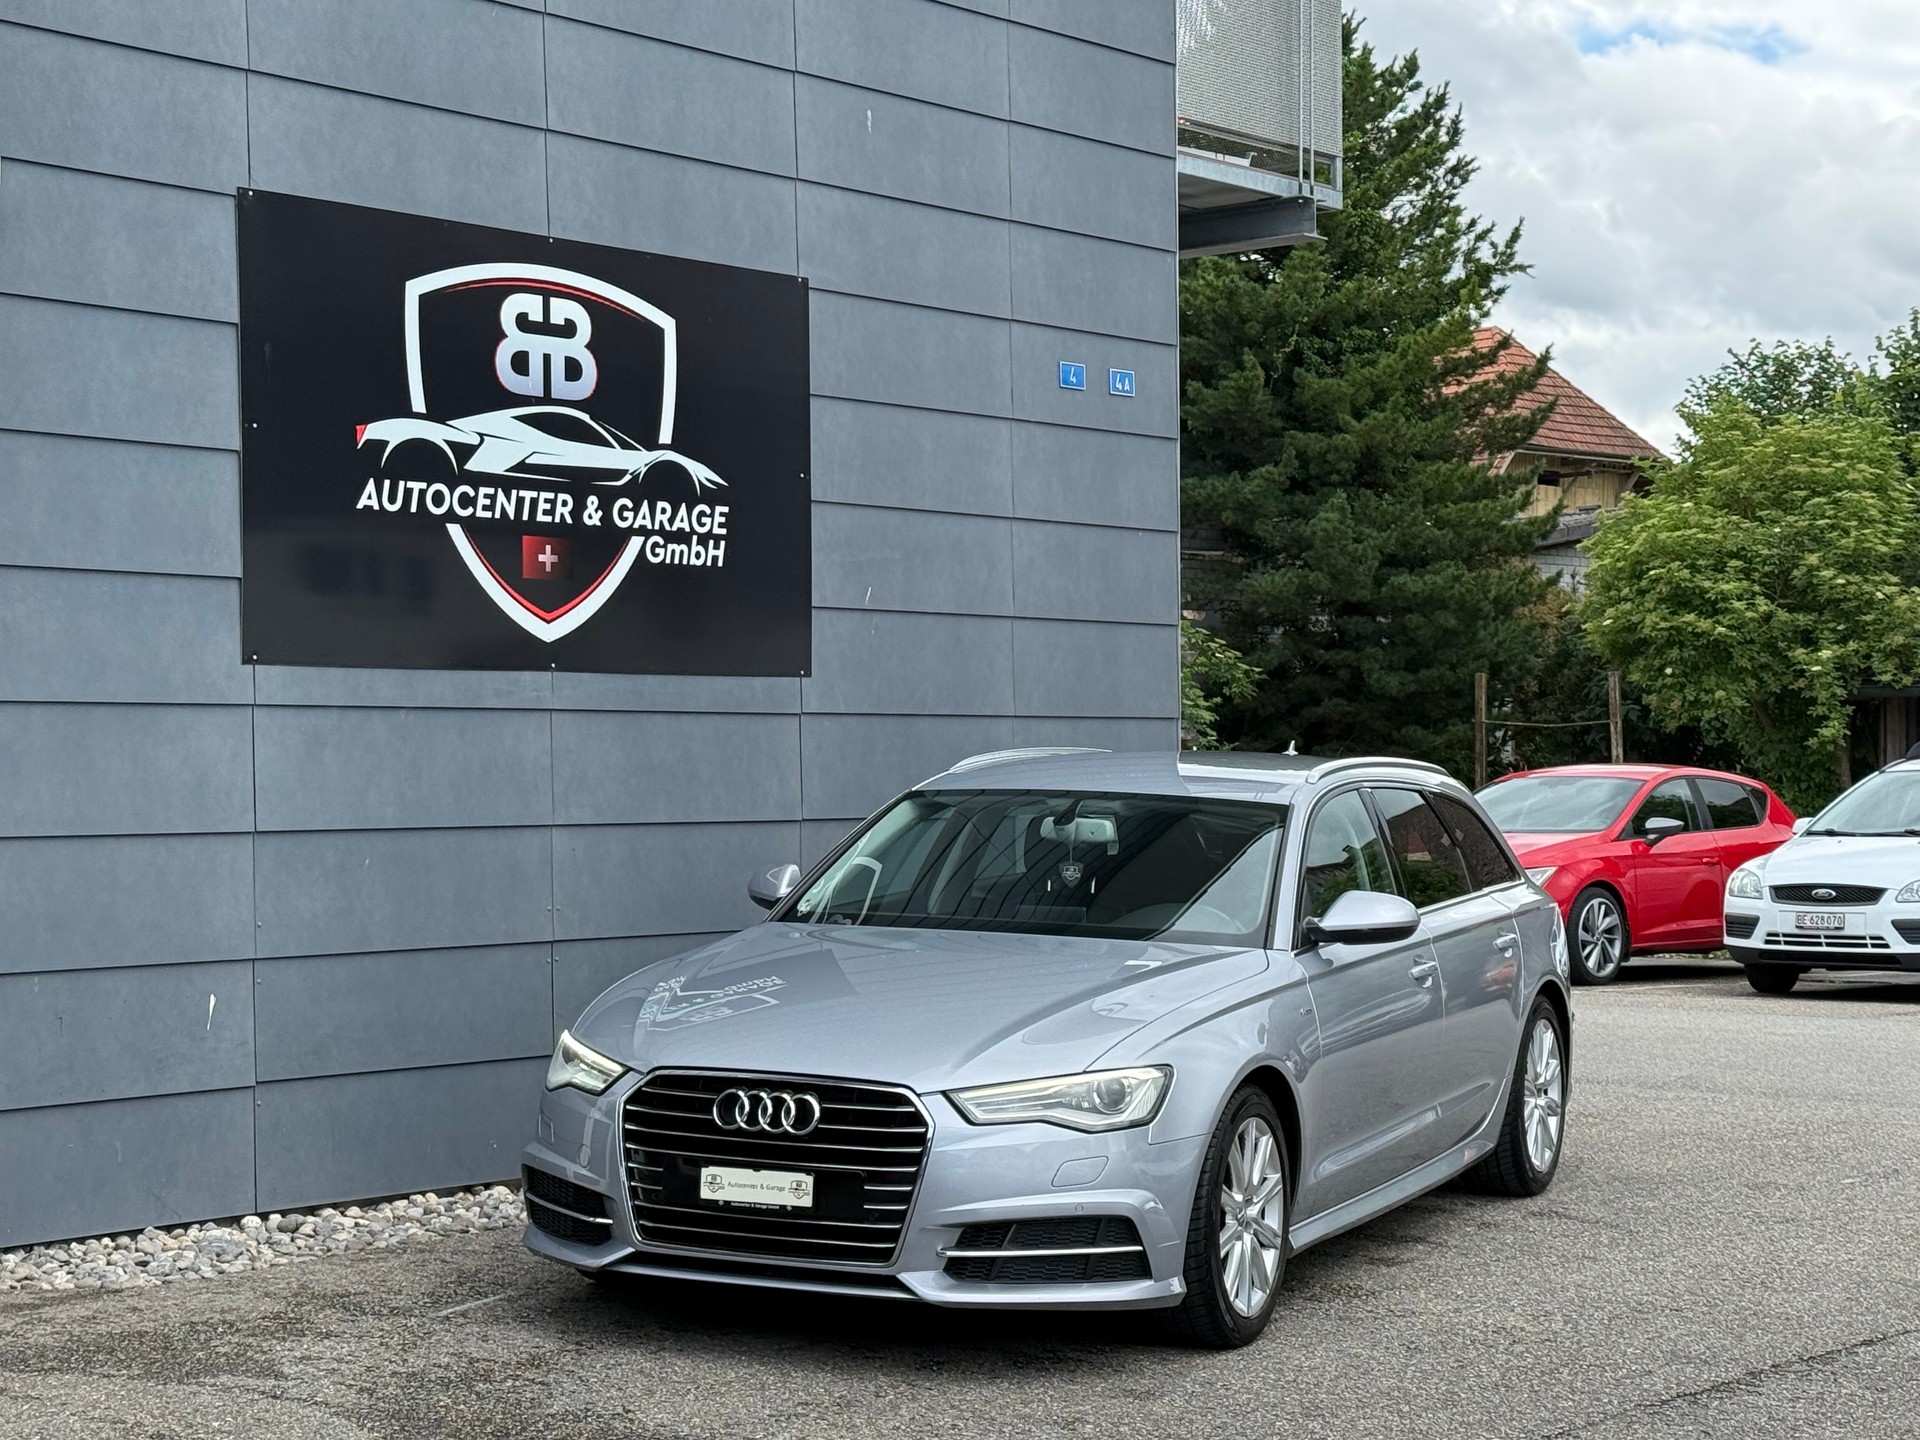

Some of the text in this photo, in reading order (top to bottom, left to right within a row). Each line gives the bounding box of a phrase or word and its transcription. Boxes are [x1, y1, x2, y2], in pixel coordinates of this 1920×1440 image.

[1069, 366, 1077, 385] 4
[1115, 373, 1130, 392] 4A
[355, 477, 730, 535] AUTOCENTER & GARAGE
[645, 534, 726, 567] GmbH
[727, 1181, 759, 1190] Autocenter
[765, 1184, 786, 1192] Garage
